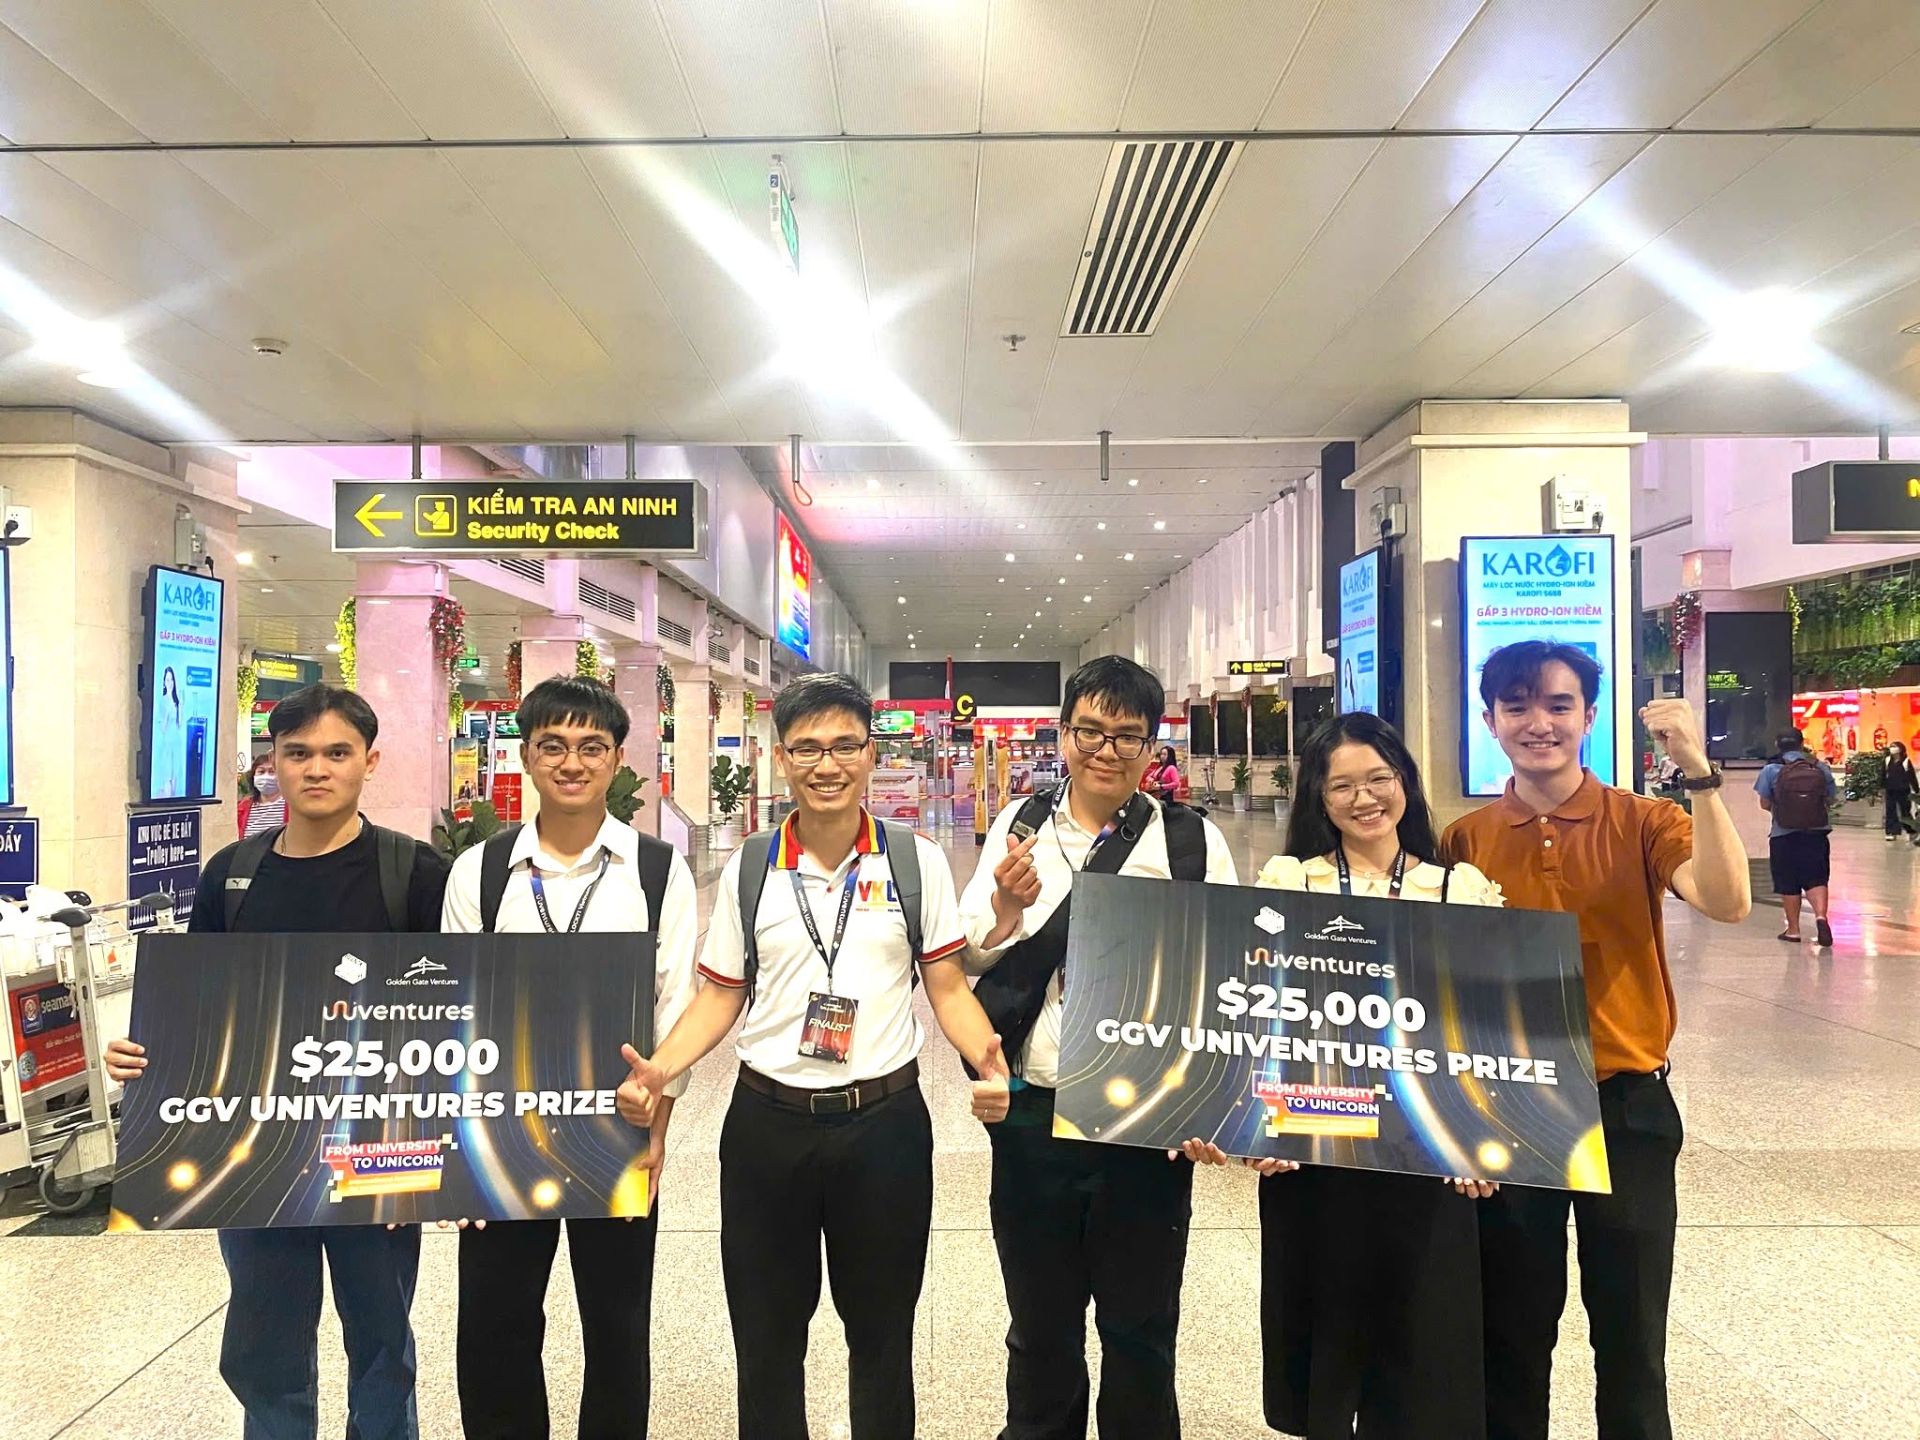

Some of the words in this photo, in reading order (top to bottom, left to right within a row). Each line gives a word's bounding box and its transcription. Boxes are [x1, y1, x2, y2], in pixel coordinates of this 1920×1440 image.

[467, 488, 524, 515] KIỂM
[530, 497, 577, 515] TRA
[582, 497, 615, 515] AN
[622, 497, 677, 516] NINH
[467, 522, 550, 543] Security
[556, 522, 620, 540] Check
[1483, 543, 1595, 577] KAROFI
[164, 582, 215, 612] KAROFI
[1477, 604, 1499, 617] GẤP
[1501, 607, 1508, 617] 3
[1510, 606, 1571, 617] HYDRO-ION
[1574, 603, 1602, 616] KIỀM
[956, 694, 974, 715] C
[172, 822, 180, 839] XE
[147, 844, 169, 866] Trolley
[170, 843, 184, 862] here
[858, 880, 898, 902] VKL
[1304, 932, 1330, 941] Golden
[1330, 935, 1347, 943] Gate
[1348, 936, 1377, 945] Ventures
[386, 978, 411, 986] Golden
[412, 978, 429, 986] Gate
[430, 978, 459, 986] Ventures
[1216, 976, 1426, 1033] $25,000
[808, 1017, 852, 1033] FINALIST
[289, 1035, 499, 1084] $25,000
[1095, 1018, 1172, 1048] GGV
[1180, 1026, 1438, 1075] UNIVENTURES
[1447, 1051, 1559, 1086] PRIZE
[1257, 1081, 1296, 1095] FROM
[1298, 1083, 1376, 1099] UNIVERSITY
[159, 1096, 242, 1124] GGV
[250, 1091, 505, 1123] UNIVENTURES
[514, 1089, 616, 1116] PRIZE
[1284, 1096, 1307, 1108] TO
[1309, 1097, 1380, 1115] UNICORN
[326, 1145, 364, 1156] FROM
[367, 1139, 443, 1154] UNIVERSITY
[352, 1156, 374, 1169] TO
[376, 1154, 445, 1168] UNICORN
